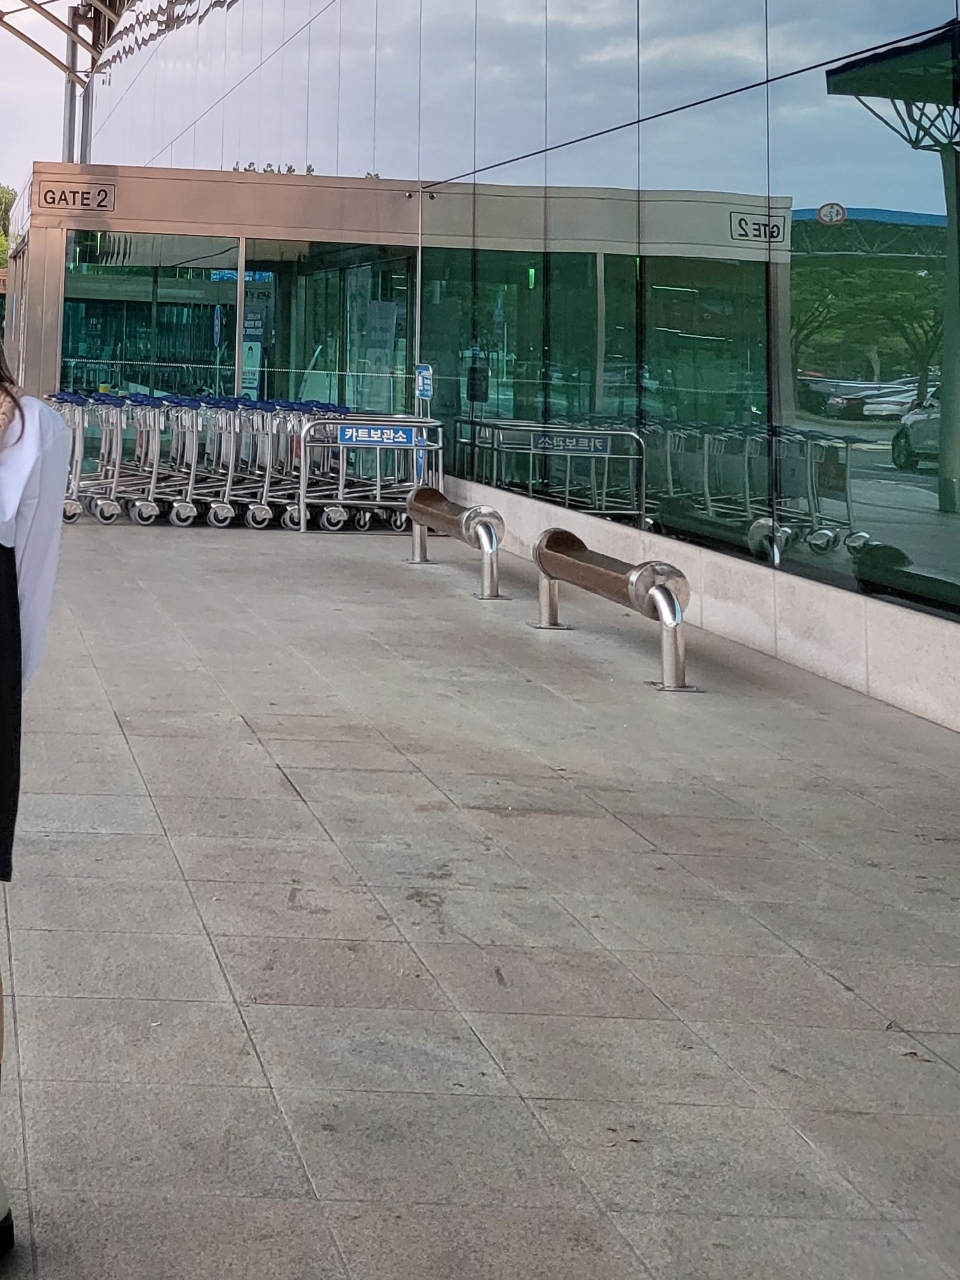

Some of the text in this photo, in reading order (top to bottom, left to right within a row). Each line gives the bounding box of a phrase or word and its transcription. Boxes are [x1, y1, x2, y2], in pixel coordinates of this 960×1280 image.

[43, 188, 109, 209] GATE 2
[344, 427, 408, 443] 카트보관소
